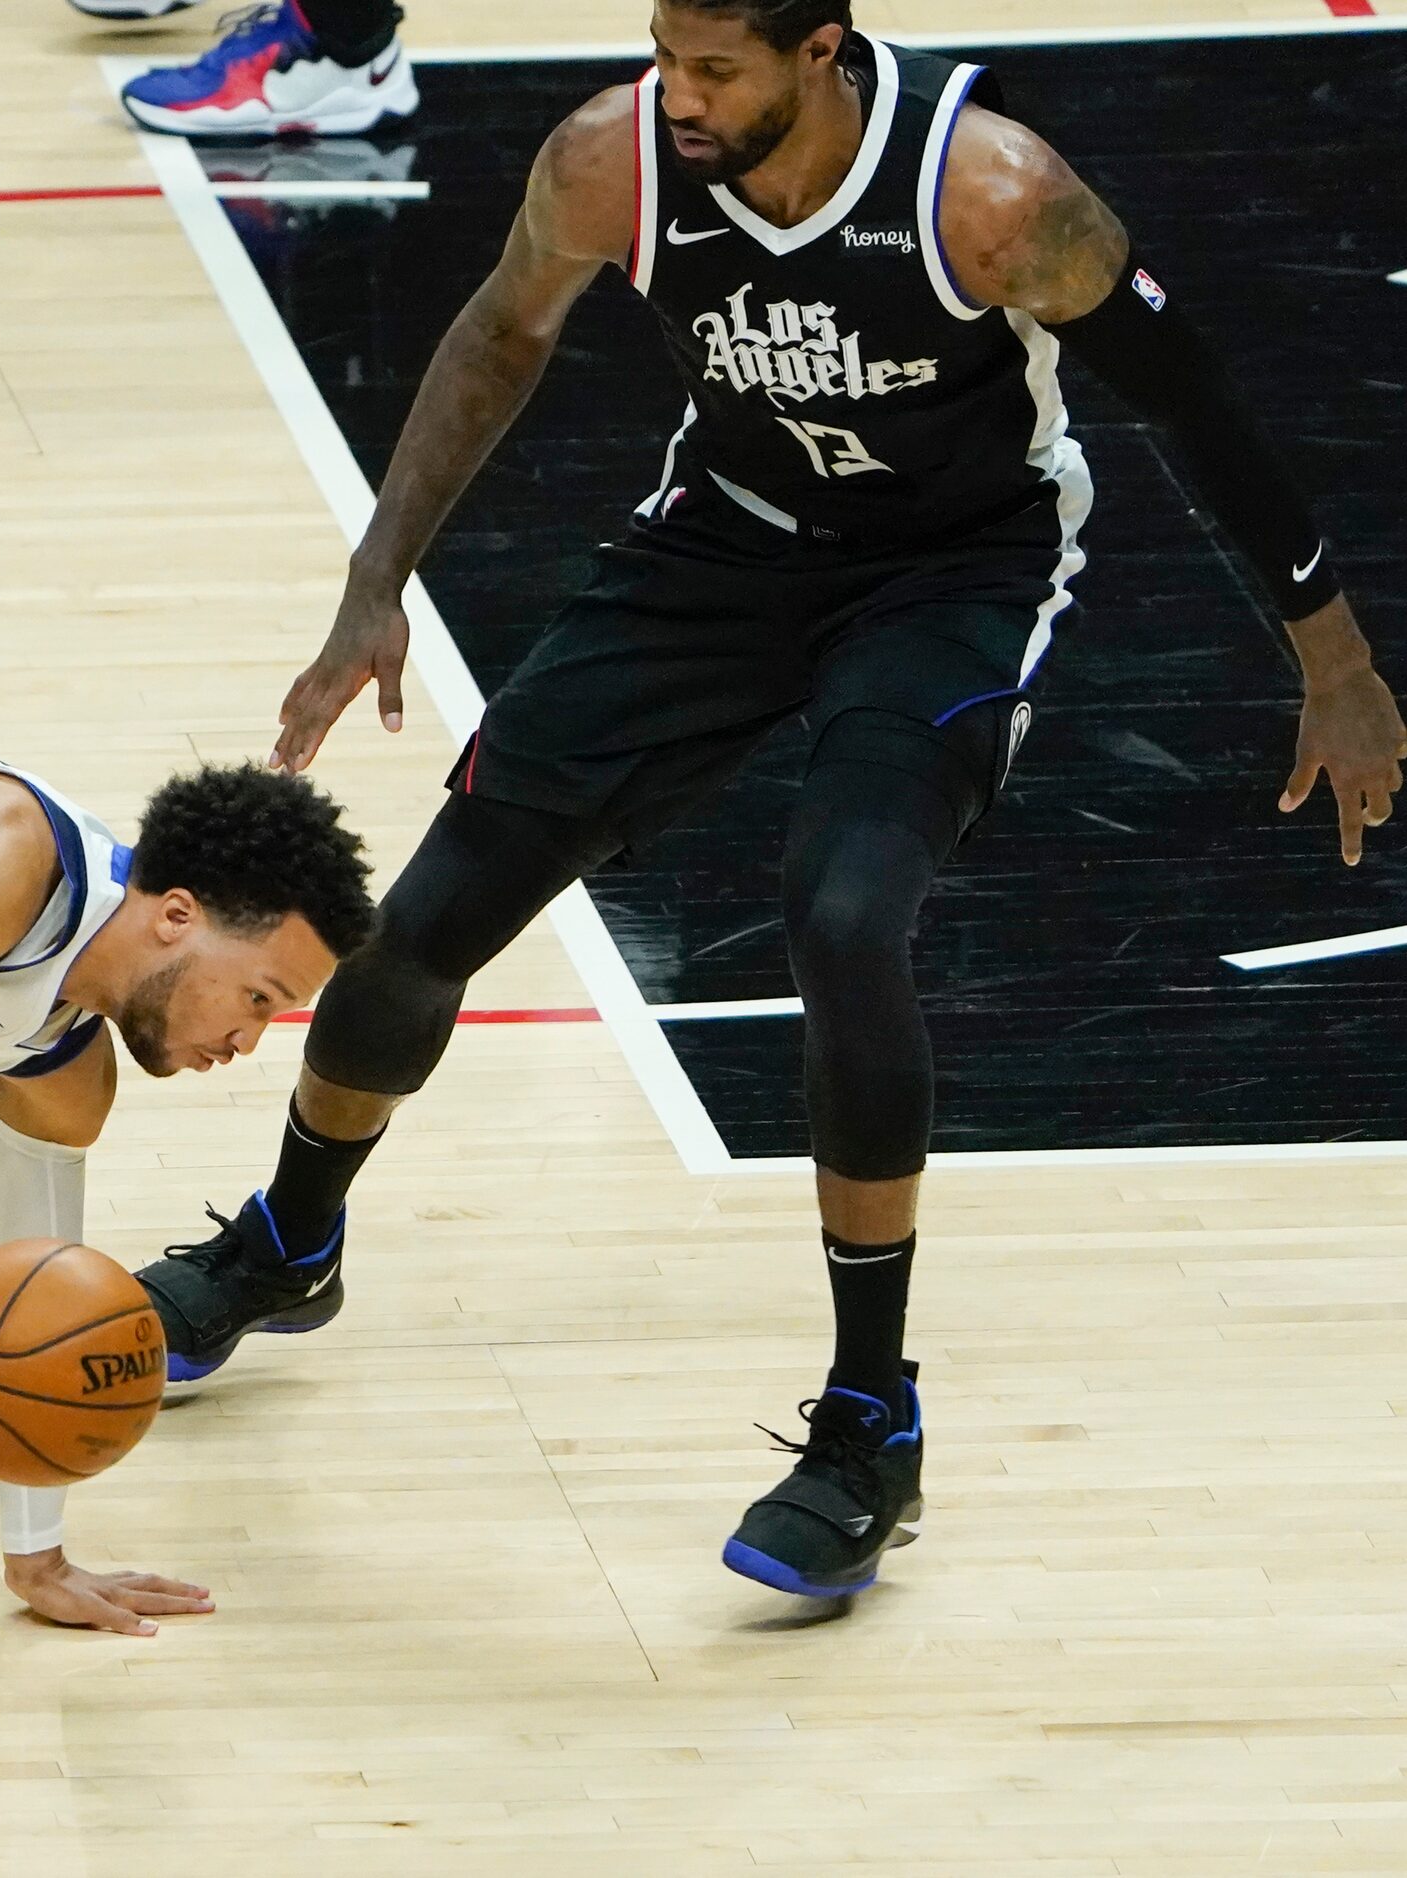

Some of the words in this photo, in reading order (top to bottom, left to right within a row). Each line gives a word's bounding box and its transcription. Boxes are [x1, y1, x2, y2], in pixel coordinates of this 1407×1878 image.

[840, 224, 916, 253] honey
[725, 282, 840, 354] Los
[692, 312, 939, 411] Angeles
[774, 416, 896, 479] 13
